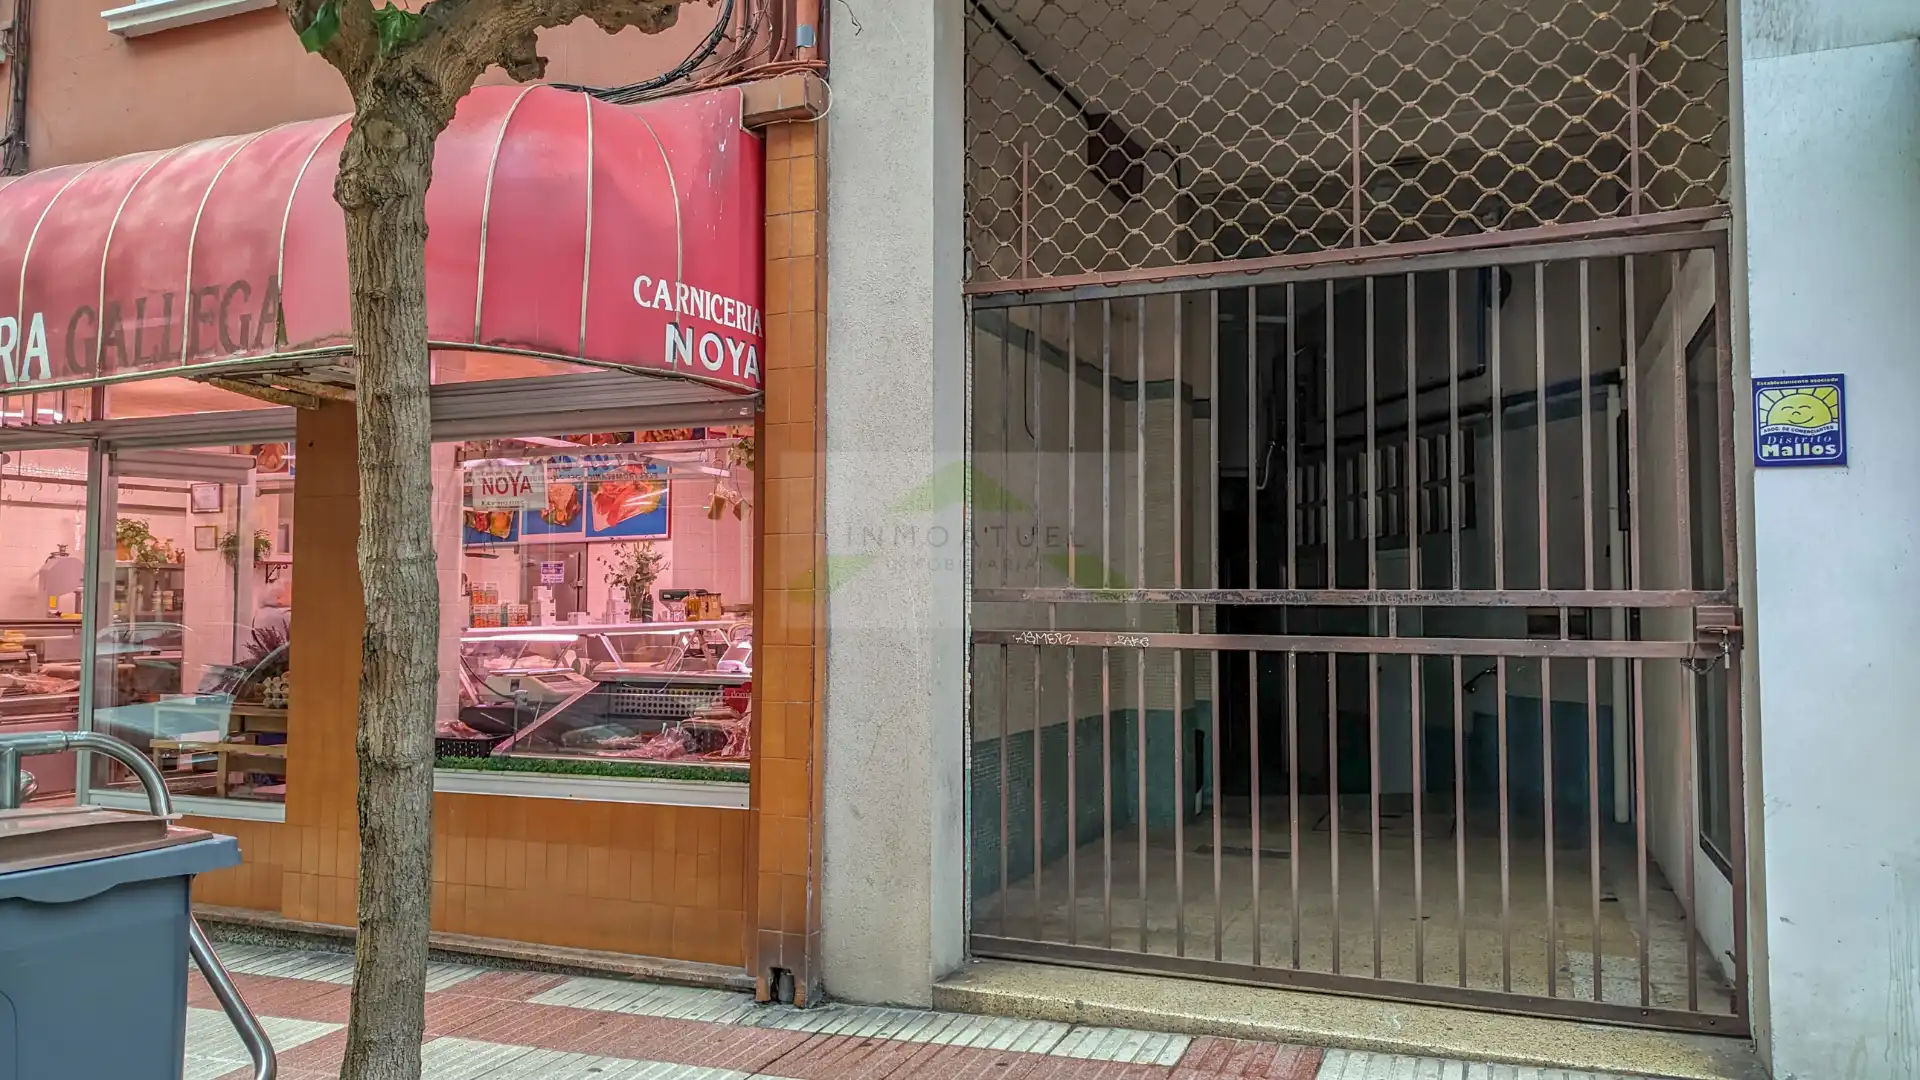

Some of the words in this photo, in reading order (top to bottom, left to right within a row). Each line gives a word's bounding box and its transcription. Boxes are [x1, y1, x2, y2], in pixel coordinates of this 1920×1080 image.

[633, 275, 763, 338] CARNICERIA
[65, 274, 288, 376] GALLEGA
[665, 322, 761, 384] NOYA
[1767, 435, 1832, 444] Distrito
[1791, 425, 1834, 434] COMERCIANTES
[1761, 443, 1837, 457] Mallos
[482, 471, 533, 496] NOYA
